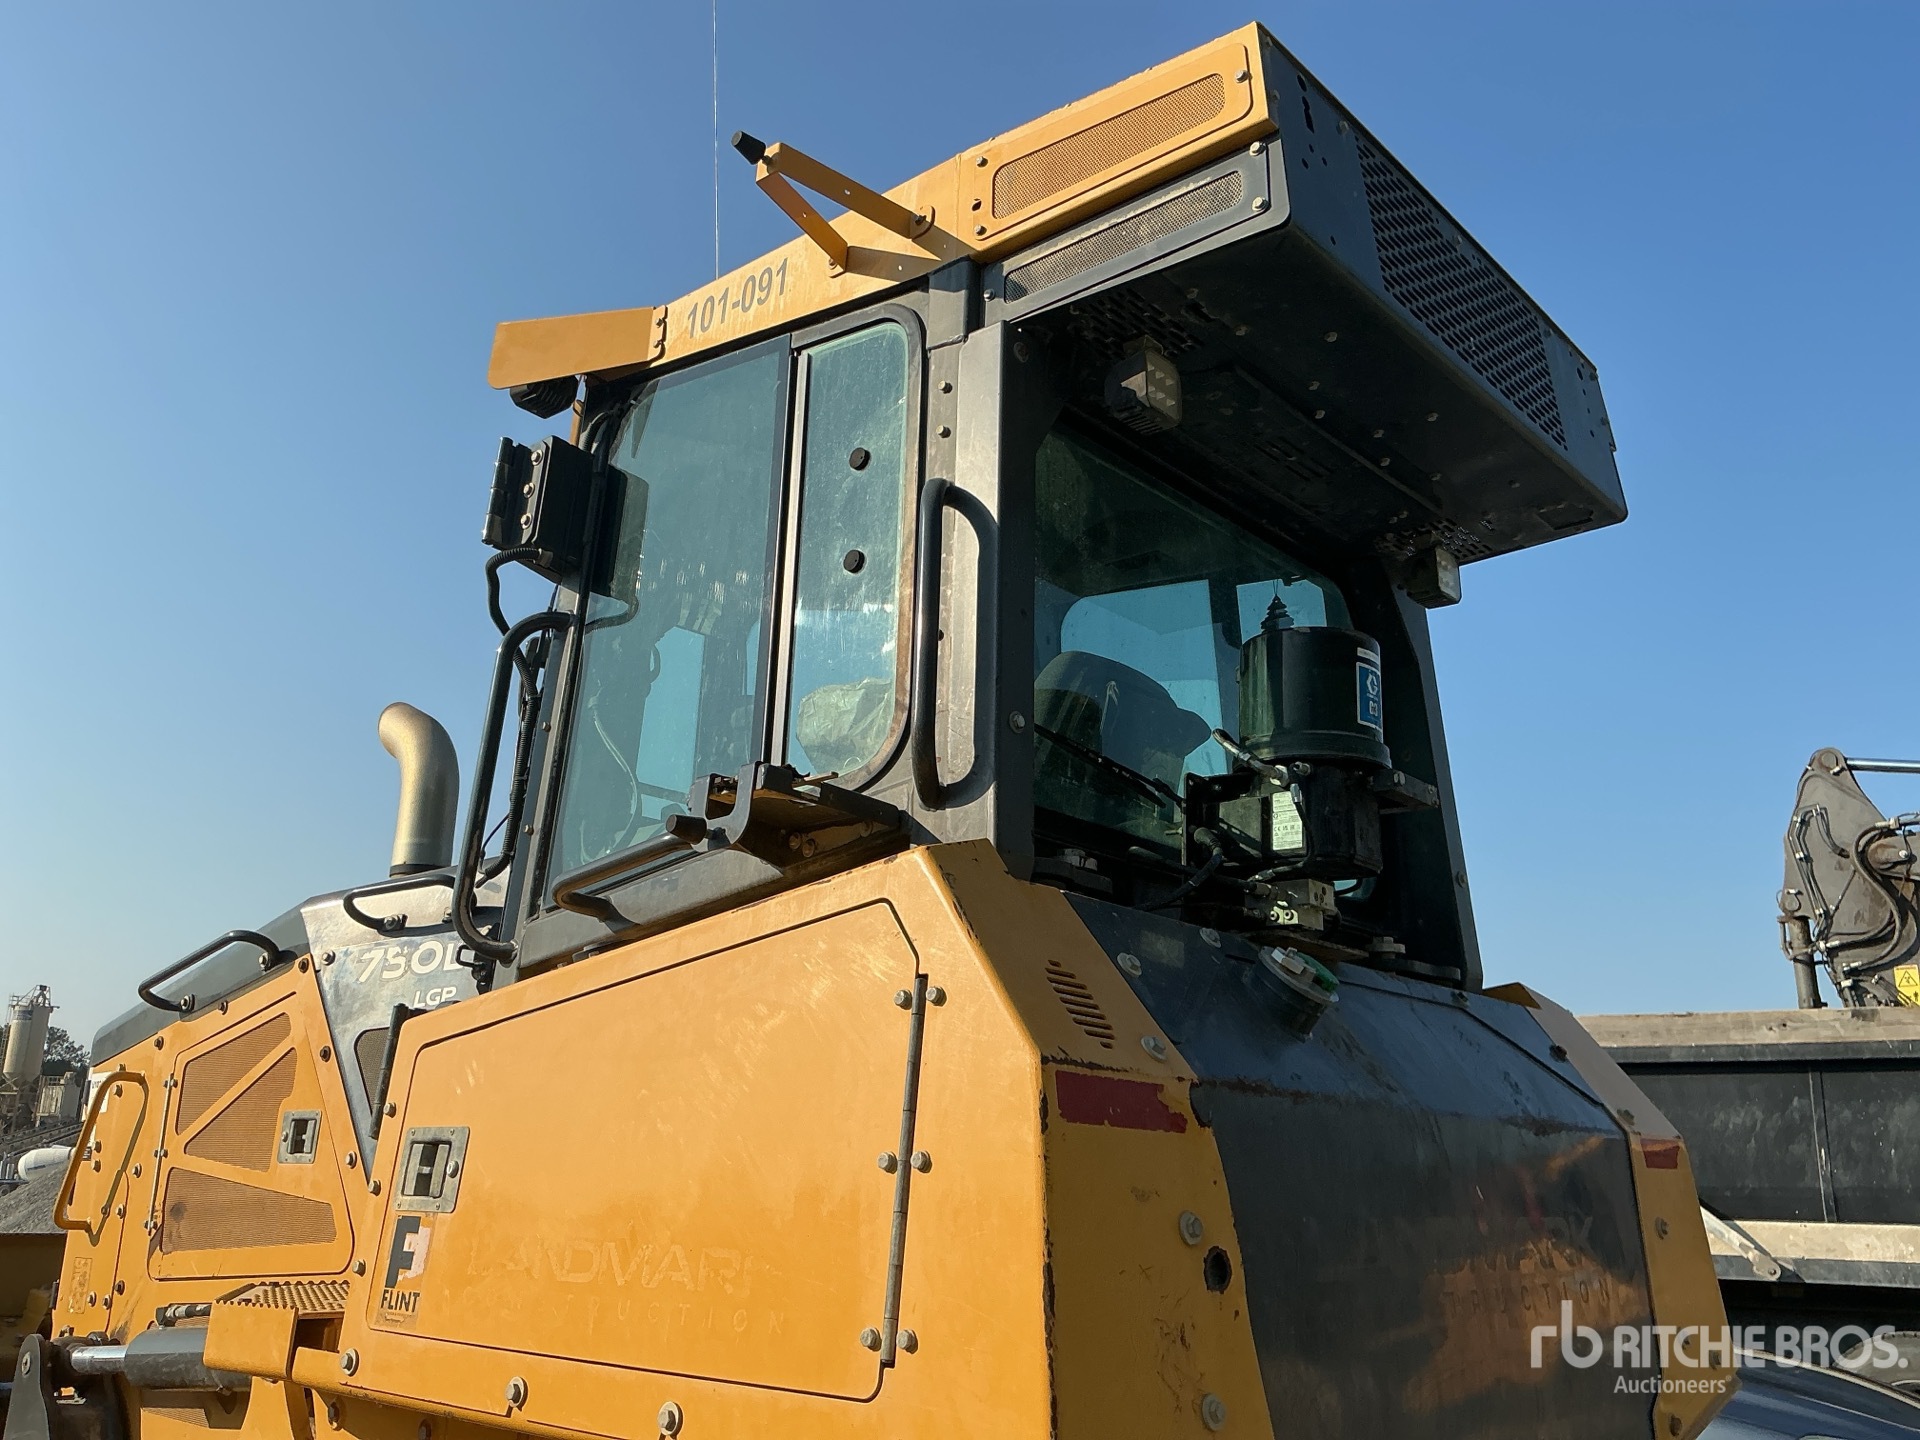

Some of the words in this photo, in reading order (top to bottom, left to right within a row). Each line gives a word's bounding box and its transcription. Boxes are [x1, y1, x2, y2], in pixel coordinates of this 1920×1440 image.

[687, 257, 788, 339] 101-091
[413, 986, 457, 1008] LGP
[380, 1288, 421, 1312] FLINT
